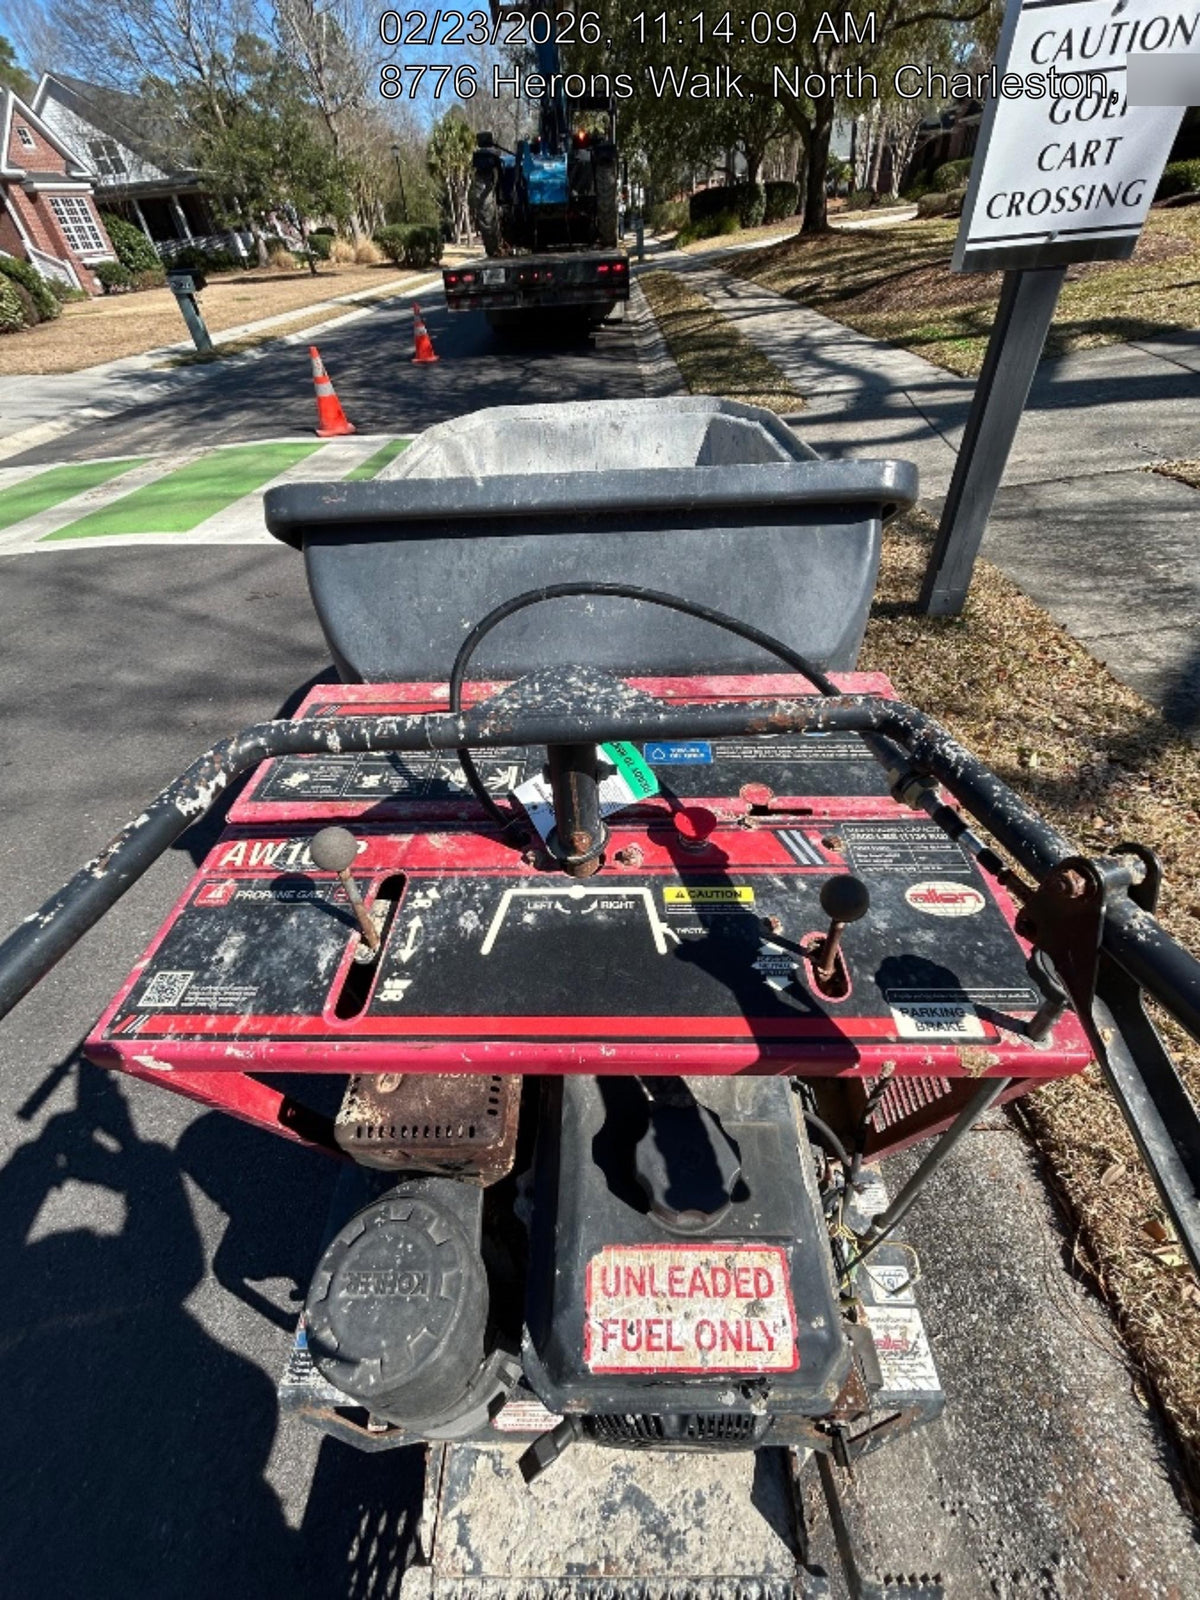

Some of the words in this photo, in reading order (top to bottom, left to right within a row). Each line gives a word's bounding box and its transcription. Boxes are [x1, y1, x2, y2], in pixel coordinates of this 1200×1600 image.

[1030, 13, 1200, 64] CAUTION
[1037, 137, 1123, 171] CART
[986, 179, 1147, 219] CROSSING
[235, 890, 297, 900] PROPANE
[527, 901, 553, 910] LEFT
[600, 901, 635, 909] RIGHT
[688, 890, 742, 899] CAUTION
[900, 1007, 966, 1018] PARKING
[916, 1021, 967, 1032] BRAKE
[602, 1265, 775, 1299] UNLEADED
[602, 1319, 685, 1352] FUEL
[695, 1319, 784, 1352] ONLY
